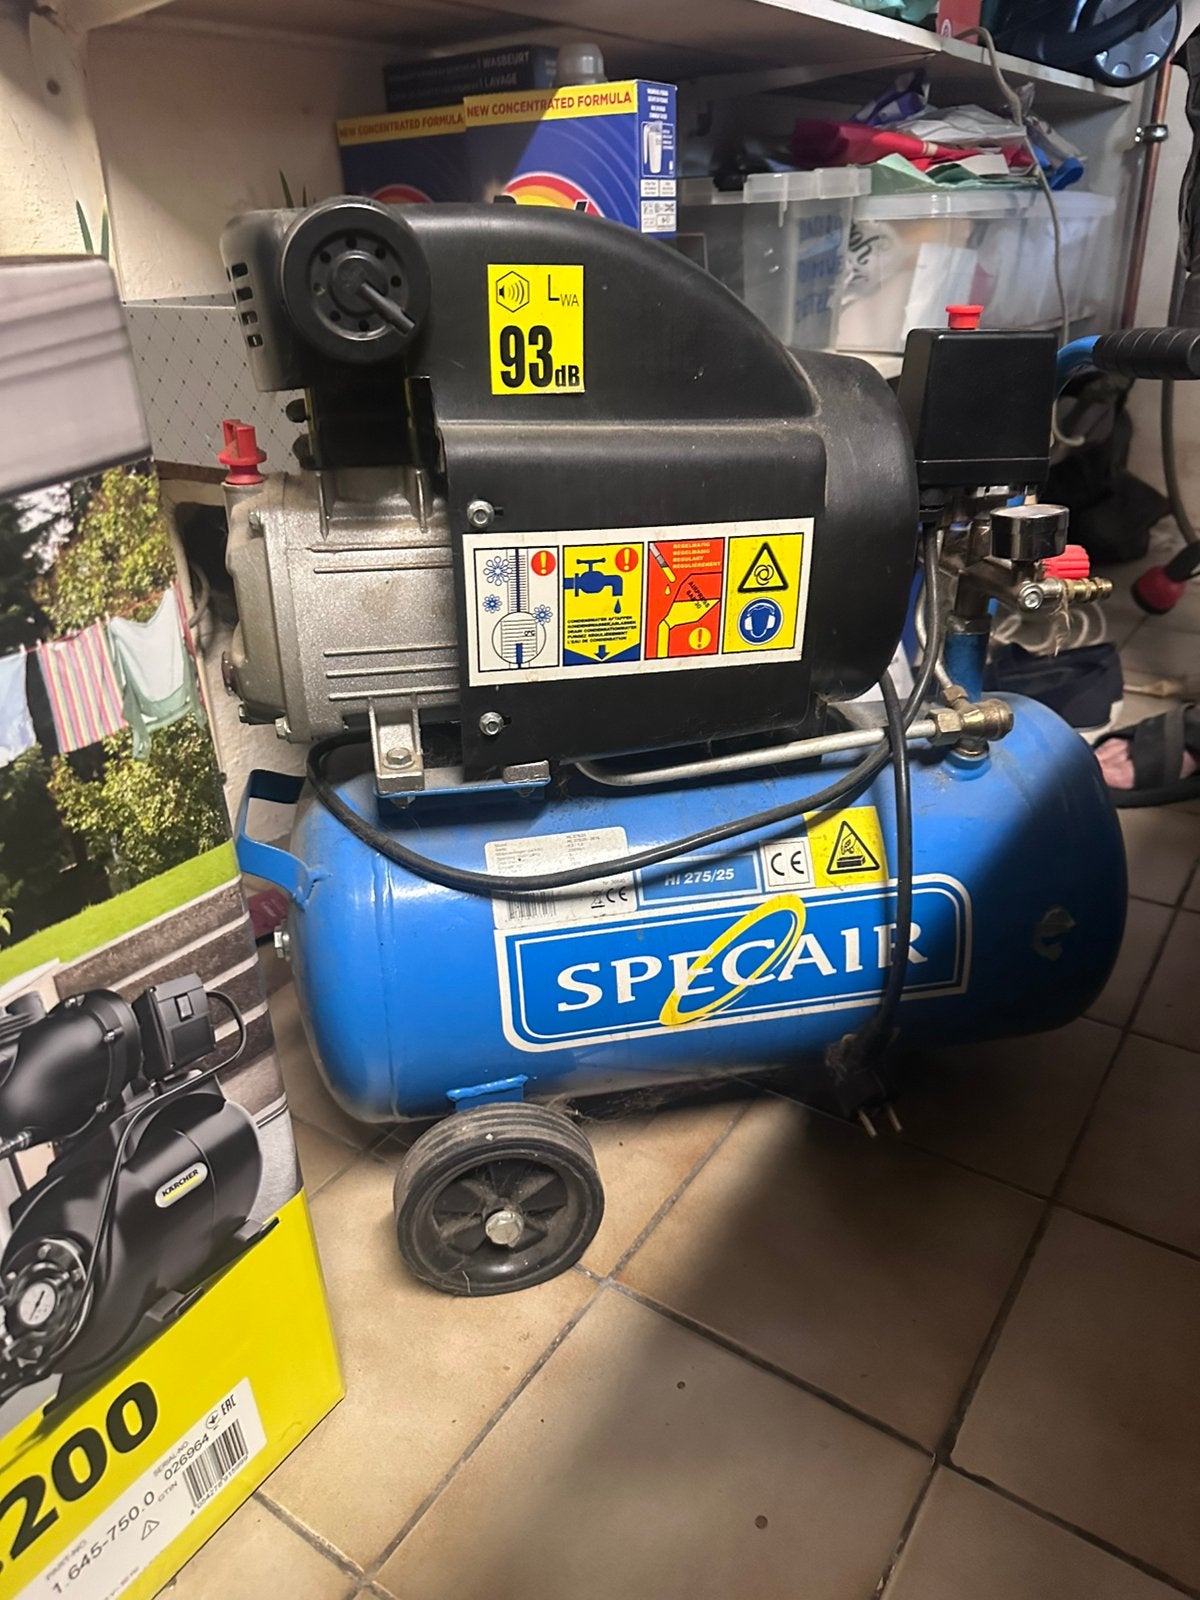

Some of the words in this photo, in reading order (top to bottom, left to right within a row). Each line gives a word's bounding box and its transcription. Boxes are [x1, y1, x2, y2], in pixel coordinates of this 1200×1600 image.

[358, 118, 421, 138] CONCENTRATED
[421, 112, 465, 129] FORMULA
[466, 105, 490, 118] NEW
[491, 97, 575, 116] CONCENTRATED
[577, 91, 632, 108] FORMULA
[499, 325, 554, 388] 93
[684, 868, 735, 885] 275/25
[557, 921, 928, 1012] SPECAIR
[164, 1433, 209, 1480] 026964
[53, 1491, 155, 1594] 1.645-750.0
